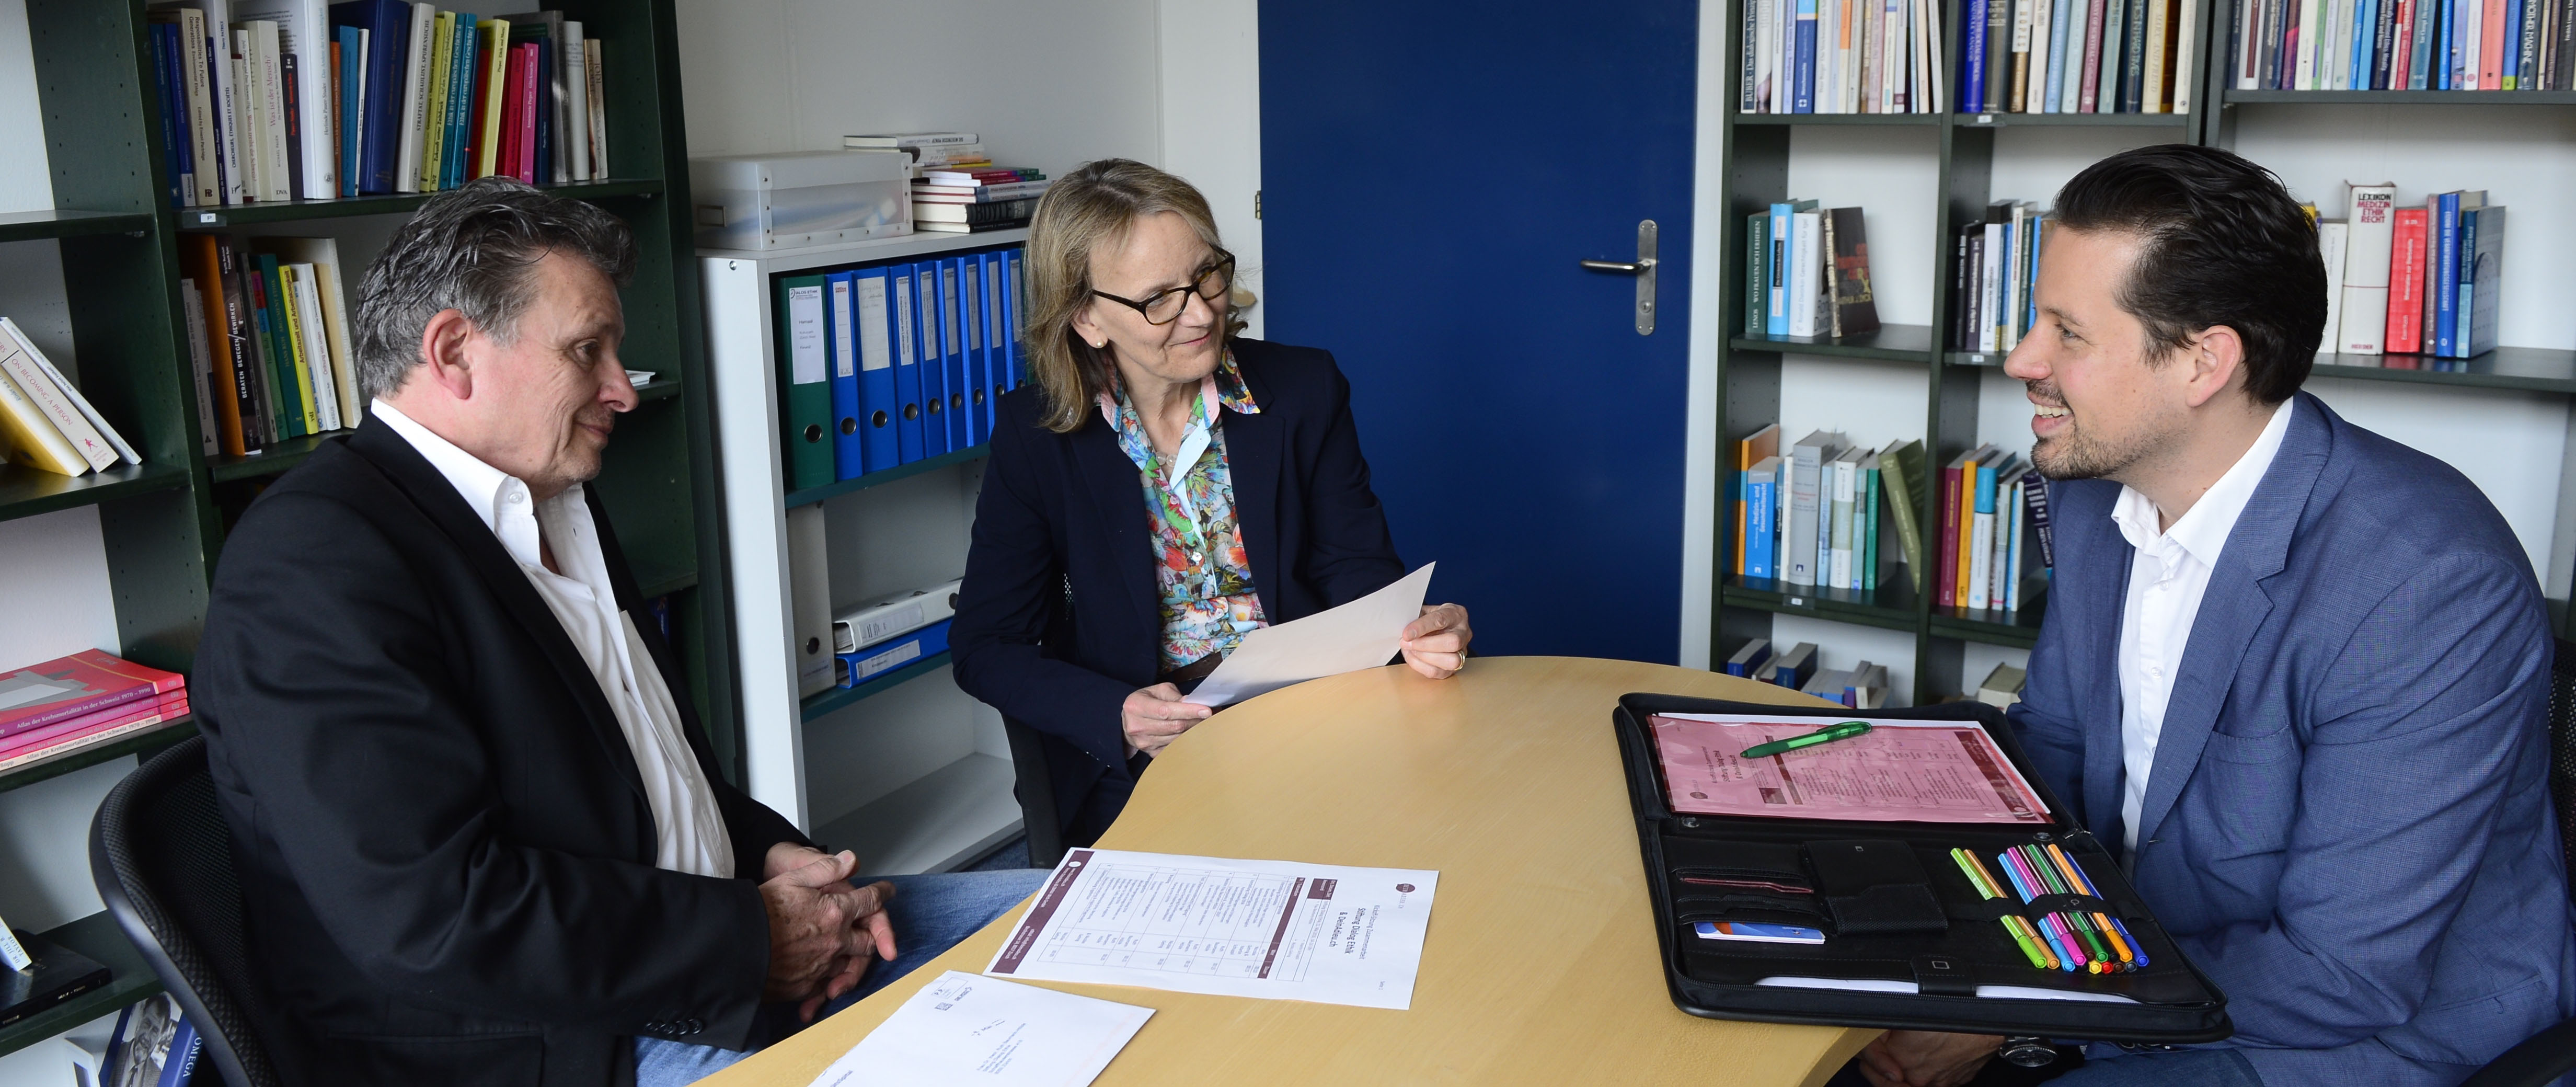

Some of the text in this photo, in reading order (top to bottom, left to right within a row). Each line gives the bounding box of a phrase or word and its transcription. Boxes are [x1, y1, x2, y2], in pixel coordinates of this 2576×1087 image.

[194, 16, 203, 59] Responsibilities
[1746, 22, 1756, 58] dialogische
[450, 59, 459, 94] europäischen
[461, 60, 472, 95] europäischen
[1745, 75, 1753, 101] BUBER
[284, 270, 297, 317] Arbeitslosigkeit
[294, 331, 305, 363] Arbeitszeit
[10, 358, 22, 370] ON
[20, 368, 49, 399] BECOMING
[52, 403, 73, 426] PERSON
[238, 370, 247, 398] BERATEN
[16, 720, 30, 728] Atlas
[41, 706, 82, 721] Krebsmortalität
[99, 695, 120, 705] Schweiz
[50, 737, 89, 752] Krebsmortalität
[106, 726, 127, 735] Schweiz
[1716, 758, 1726, 767] Dialog
[1720, 768, 1731, 782] Stiftung
[7, 935, 24, 956] TAYLOR
[1328, 916, 1347, 947] DeinAdieu.ch
[1343, 907, 1365, 954] Stiftung Dialog Ethik
[1358, 905, 1381, 960] Kickoff-Sitzung Zusammenarbeit
[180, 1036, 204, 1079] OMEGA
